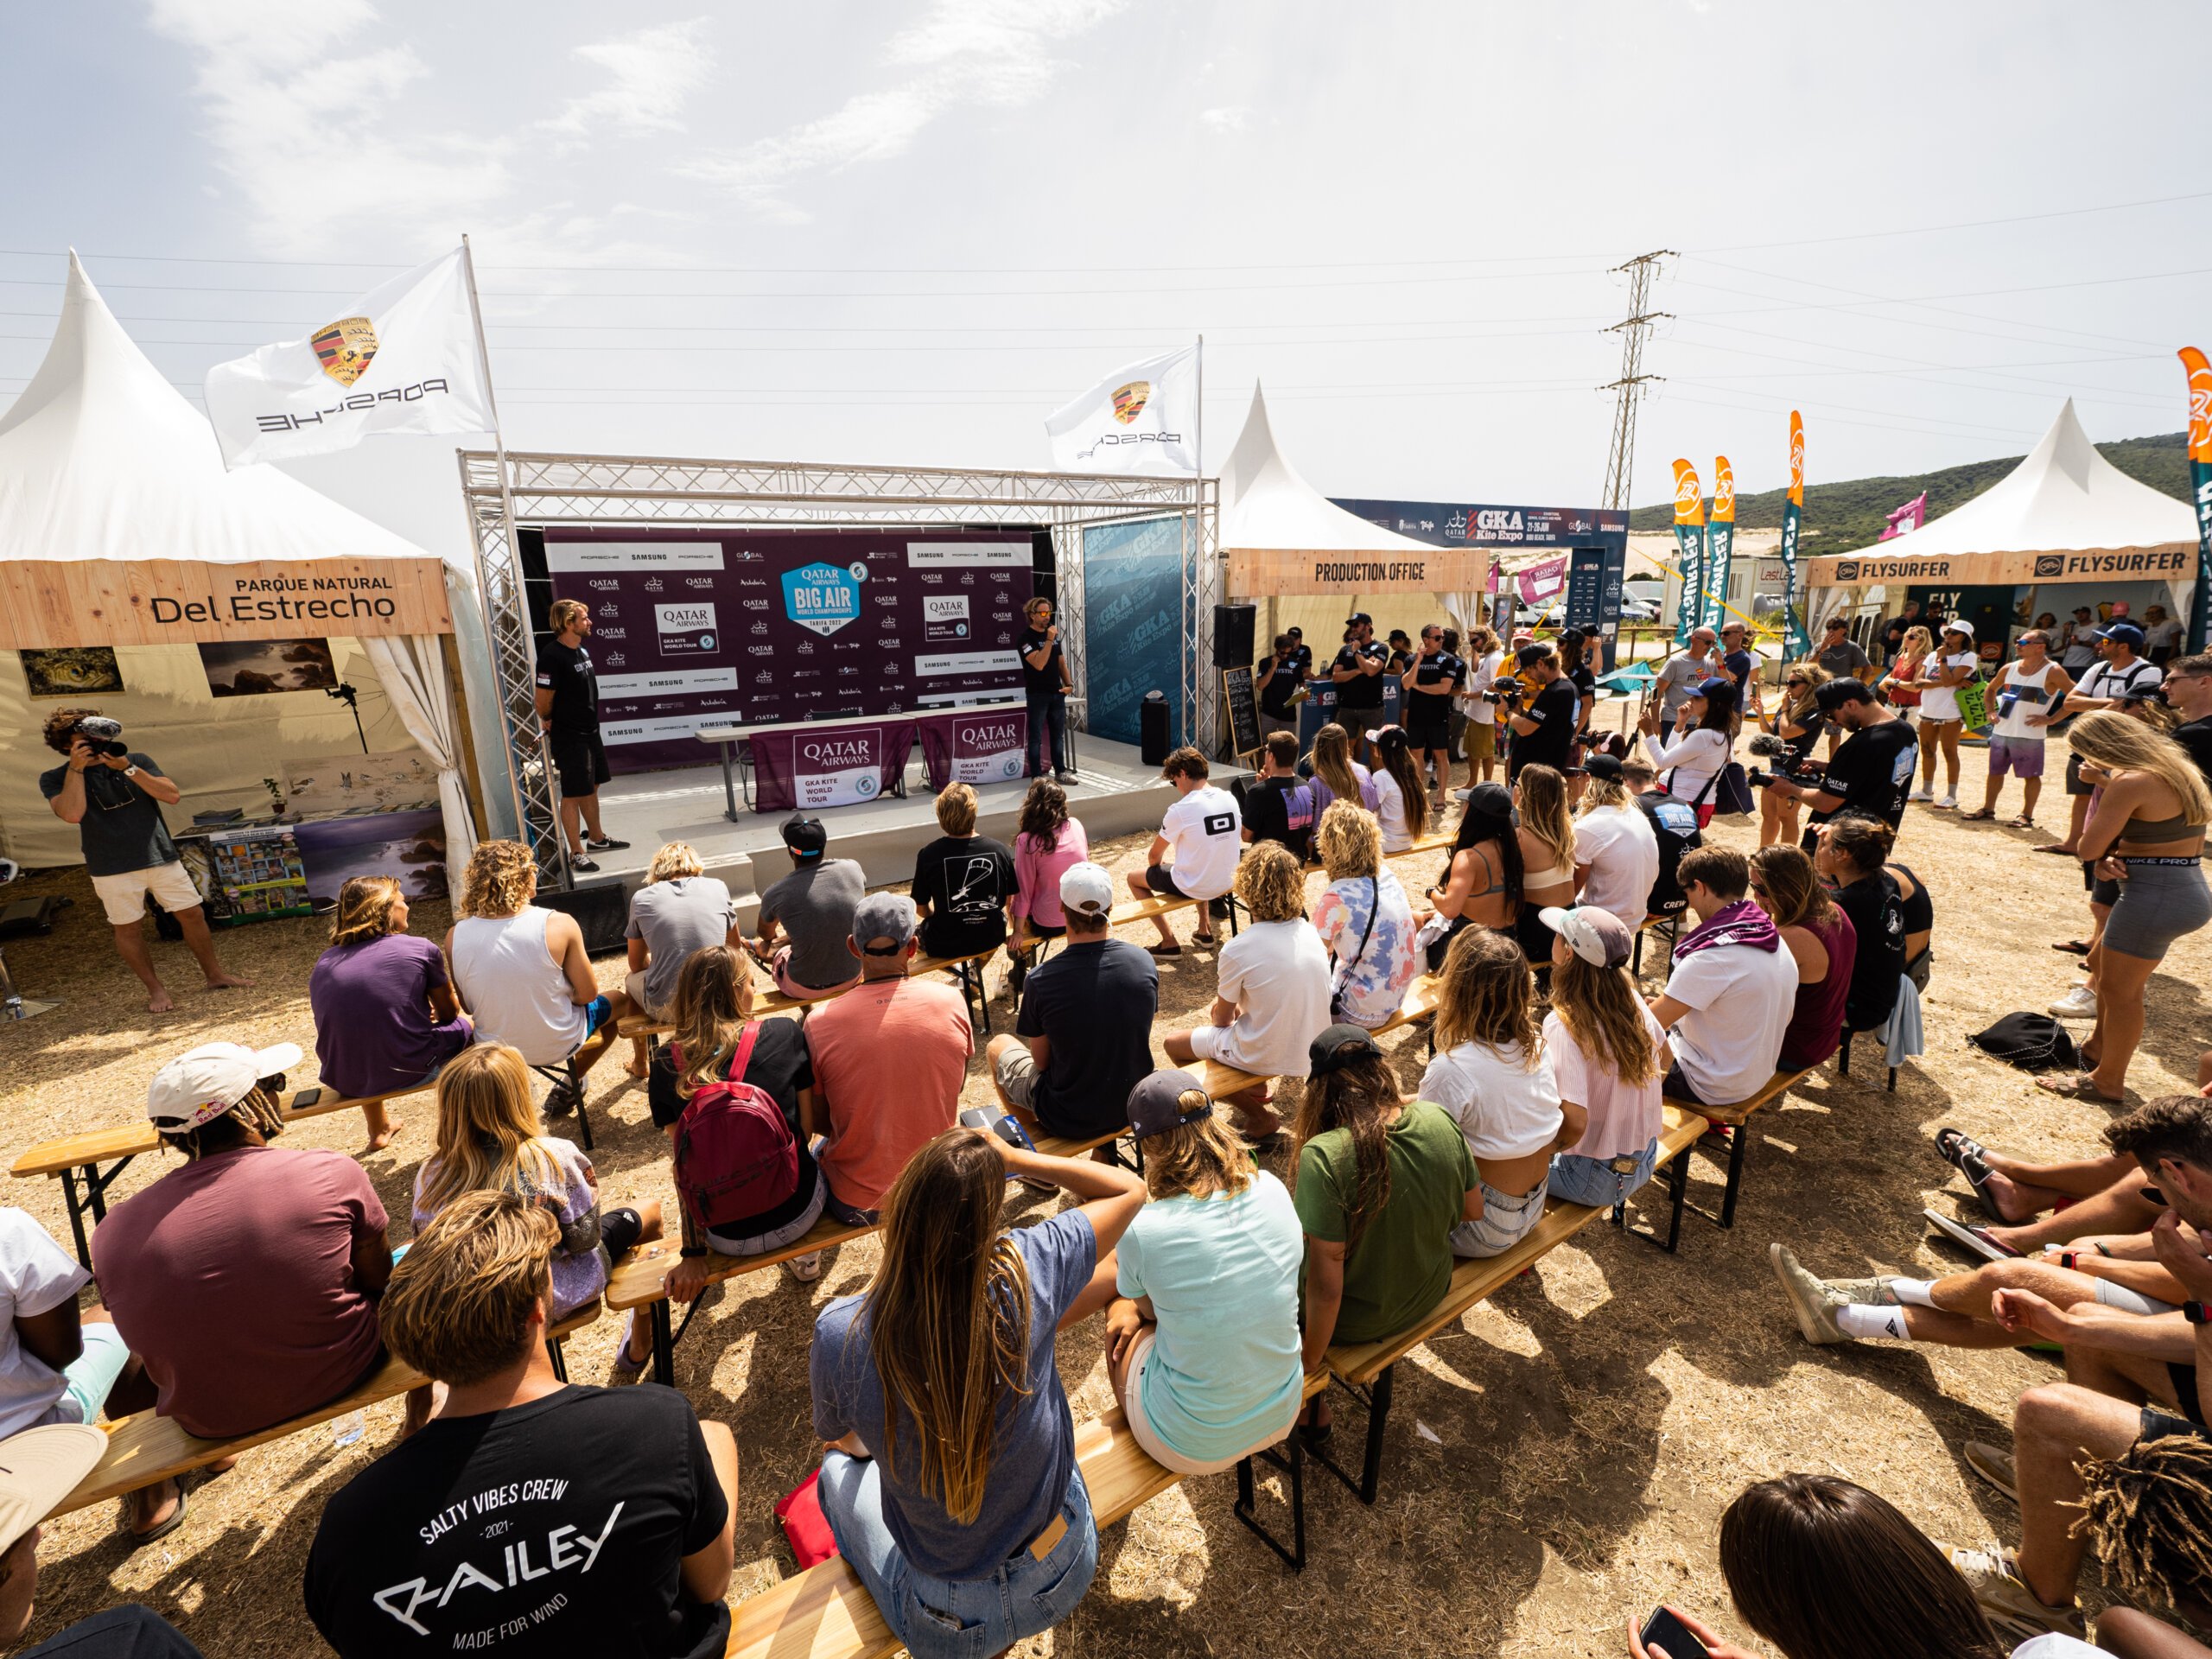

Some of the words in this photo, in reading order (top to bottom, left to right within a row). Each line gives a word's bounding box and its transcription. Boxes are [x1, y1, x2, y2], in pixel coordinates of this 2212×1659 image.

[1477, 510, 1523, 531] GKA
[1600, 523, 1625, 532] SAMSUNG
[1476, 530, 1497, 540] Kite
[1498, 531, 1523, 542] Expo
[1862, 562, 1950, 578] FLYSURFER
[2068, 552, 2187, 574] FLYSURFER
[802, 569, 839, 581] QATAR
[1315, 562, 1386, 582] PRODUCTION
[1389, 562, 1425, 581] OFFICE
[235, 578, 308, 593] PARQUE
[313, 577, 393, 591] NATURAL
[589, 579, 619, 588] QATAR
[743, 599, 769, 607] QATAR
[795, 588, 821, 609] BIG
[825, 587, 852, 608] AIR
[150, 596, 221, 624] Del
[230, 593, 396, 622] Estrecho
[930, 601, 963, 612] QATAR
[1100, 594, 1132, 626] GKA
[663, 610, 708, 623] QATAR
[596, 628, 625, 636] QATAR
[1134, 609, 1170, 642] GKA
[748, 645, 773, 654] QATAR
[1104, 677, 1132, 705] GKA
[1532, 708, 1547, 718] QATAR
[608, 728, 643, 737] SAMSUNG
[962, 723, 1016, 746] QATAR
[804, 740, 869, 761] QATAR
[975, 737, 1016, 751] AIRWAYS
[821, 754, 870, 767] AIRWAYS
[1827, 777, 1848, 788] QATAR
[806, 787, 833, 795] WORLD
[1665, 813, 1679, 823] BIG
[1663, 900, 1686, 909] CREW
[198, 1112, 213, 1123] Red
[212, 1102, 226, 1113] Bull
[420, 1500, 468, 1545] SALTY
[472, 1483, 519, 1514] VIBES
[522, 1479, 569, 1501] CREW
[373, 1501, 625, 1636] RAILEY
[452, 1627, 495, 1650] MADE
[500, 1617, 529, 1640] FOR
[530, 1593, 568, 1624] WIND
